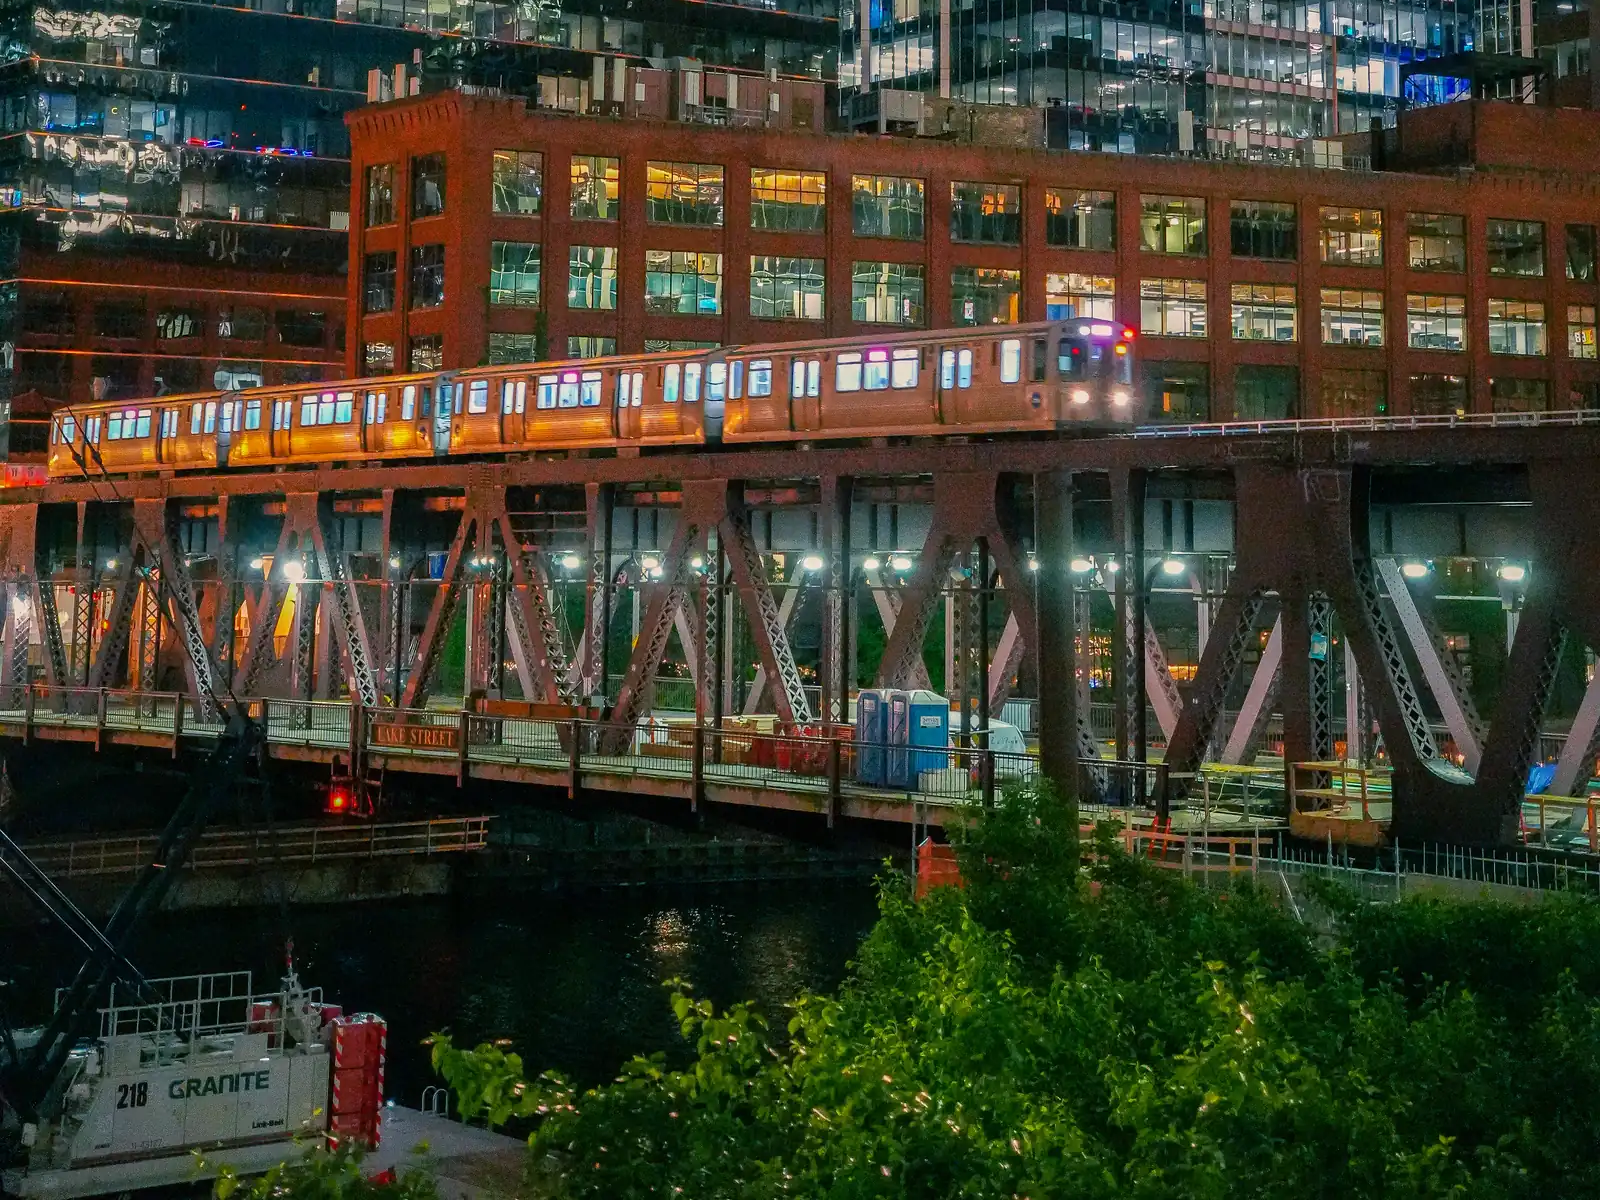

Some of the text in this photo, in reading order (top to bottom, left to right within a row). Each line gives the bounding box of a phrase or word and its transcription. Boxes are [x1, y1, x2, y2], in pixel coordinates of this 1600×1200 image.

[377, 726, 454, 746] LAKE STREET
[117, 1081, 148, 1109] 218
[169, 1070, 270, 1099] GRANITE
